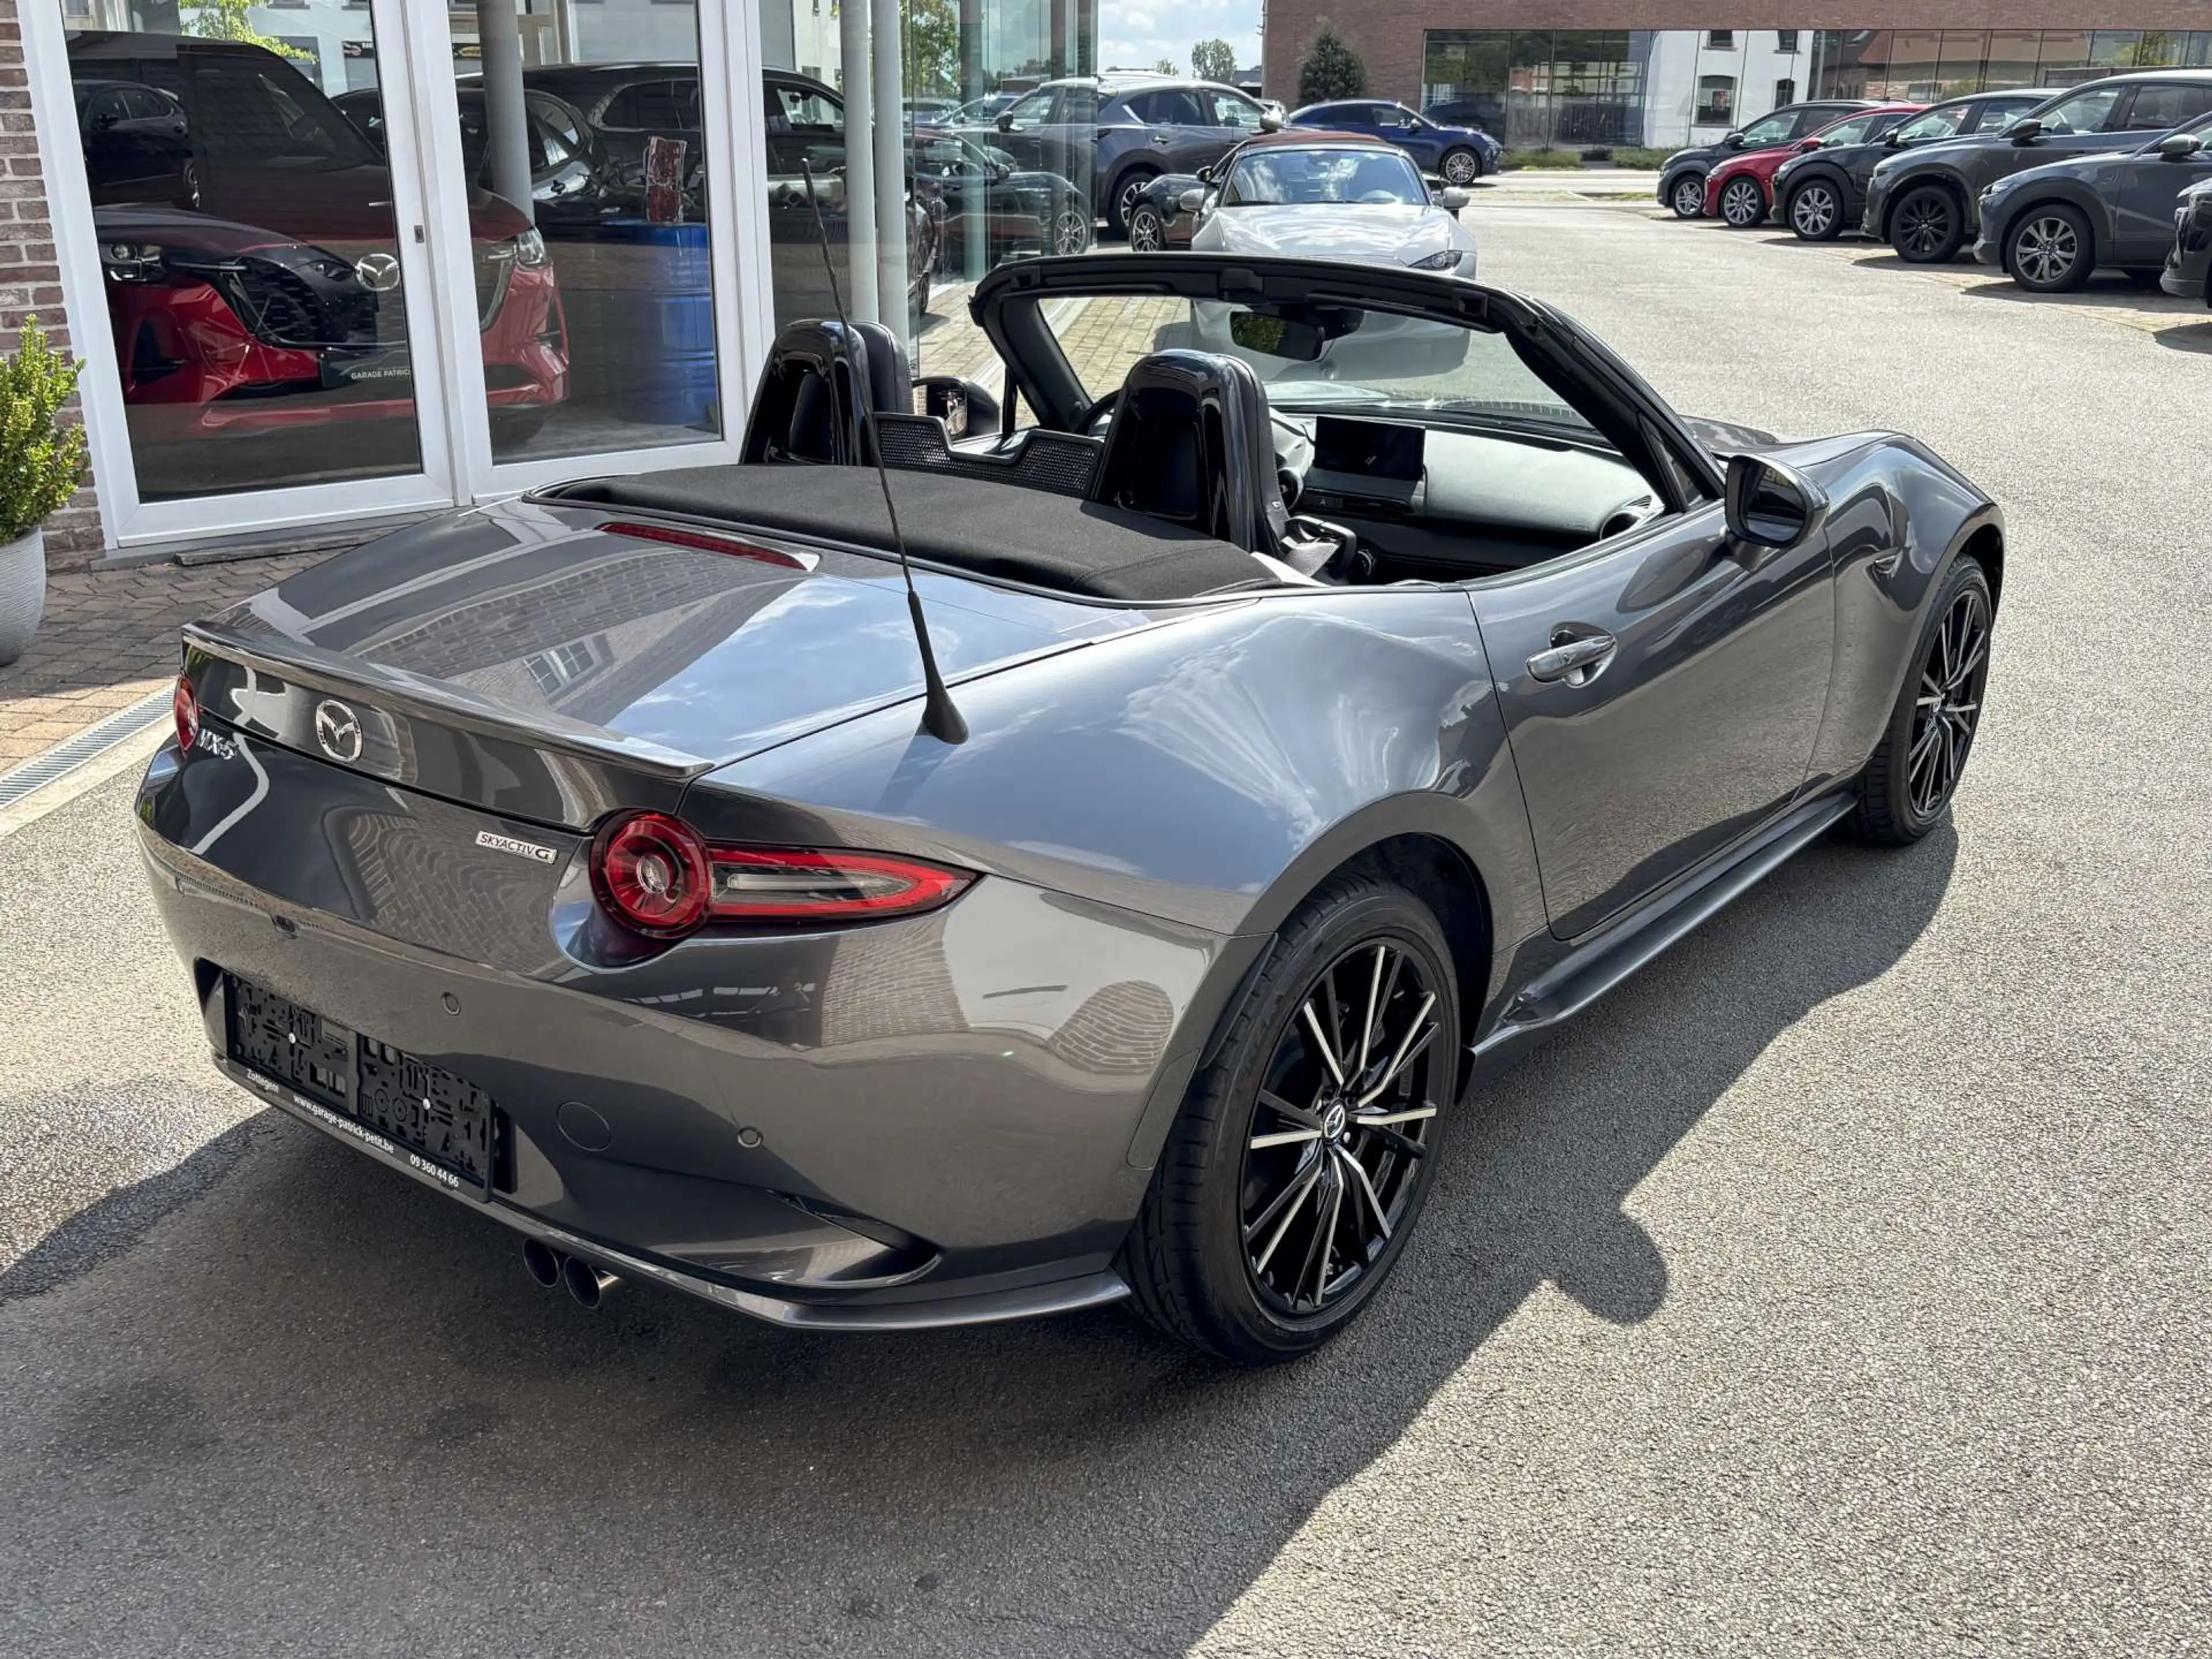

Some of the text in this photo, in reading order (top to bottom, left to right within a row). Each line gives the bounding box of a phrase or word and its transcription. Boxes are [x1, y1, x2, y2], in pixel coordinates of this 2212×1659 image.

[383, 369, 411, 377] PATRIC
[480, 834, 535, 854] SKYACTIV
[247, 1068, 459, 1187] Zottegem www.garage-patrick-petit.be 09 360 44 66
